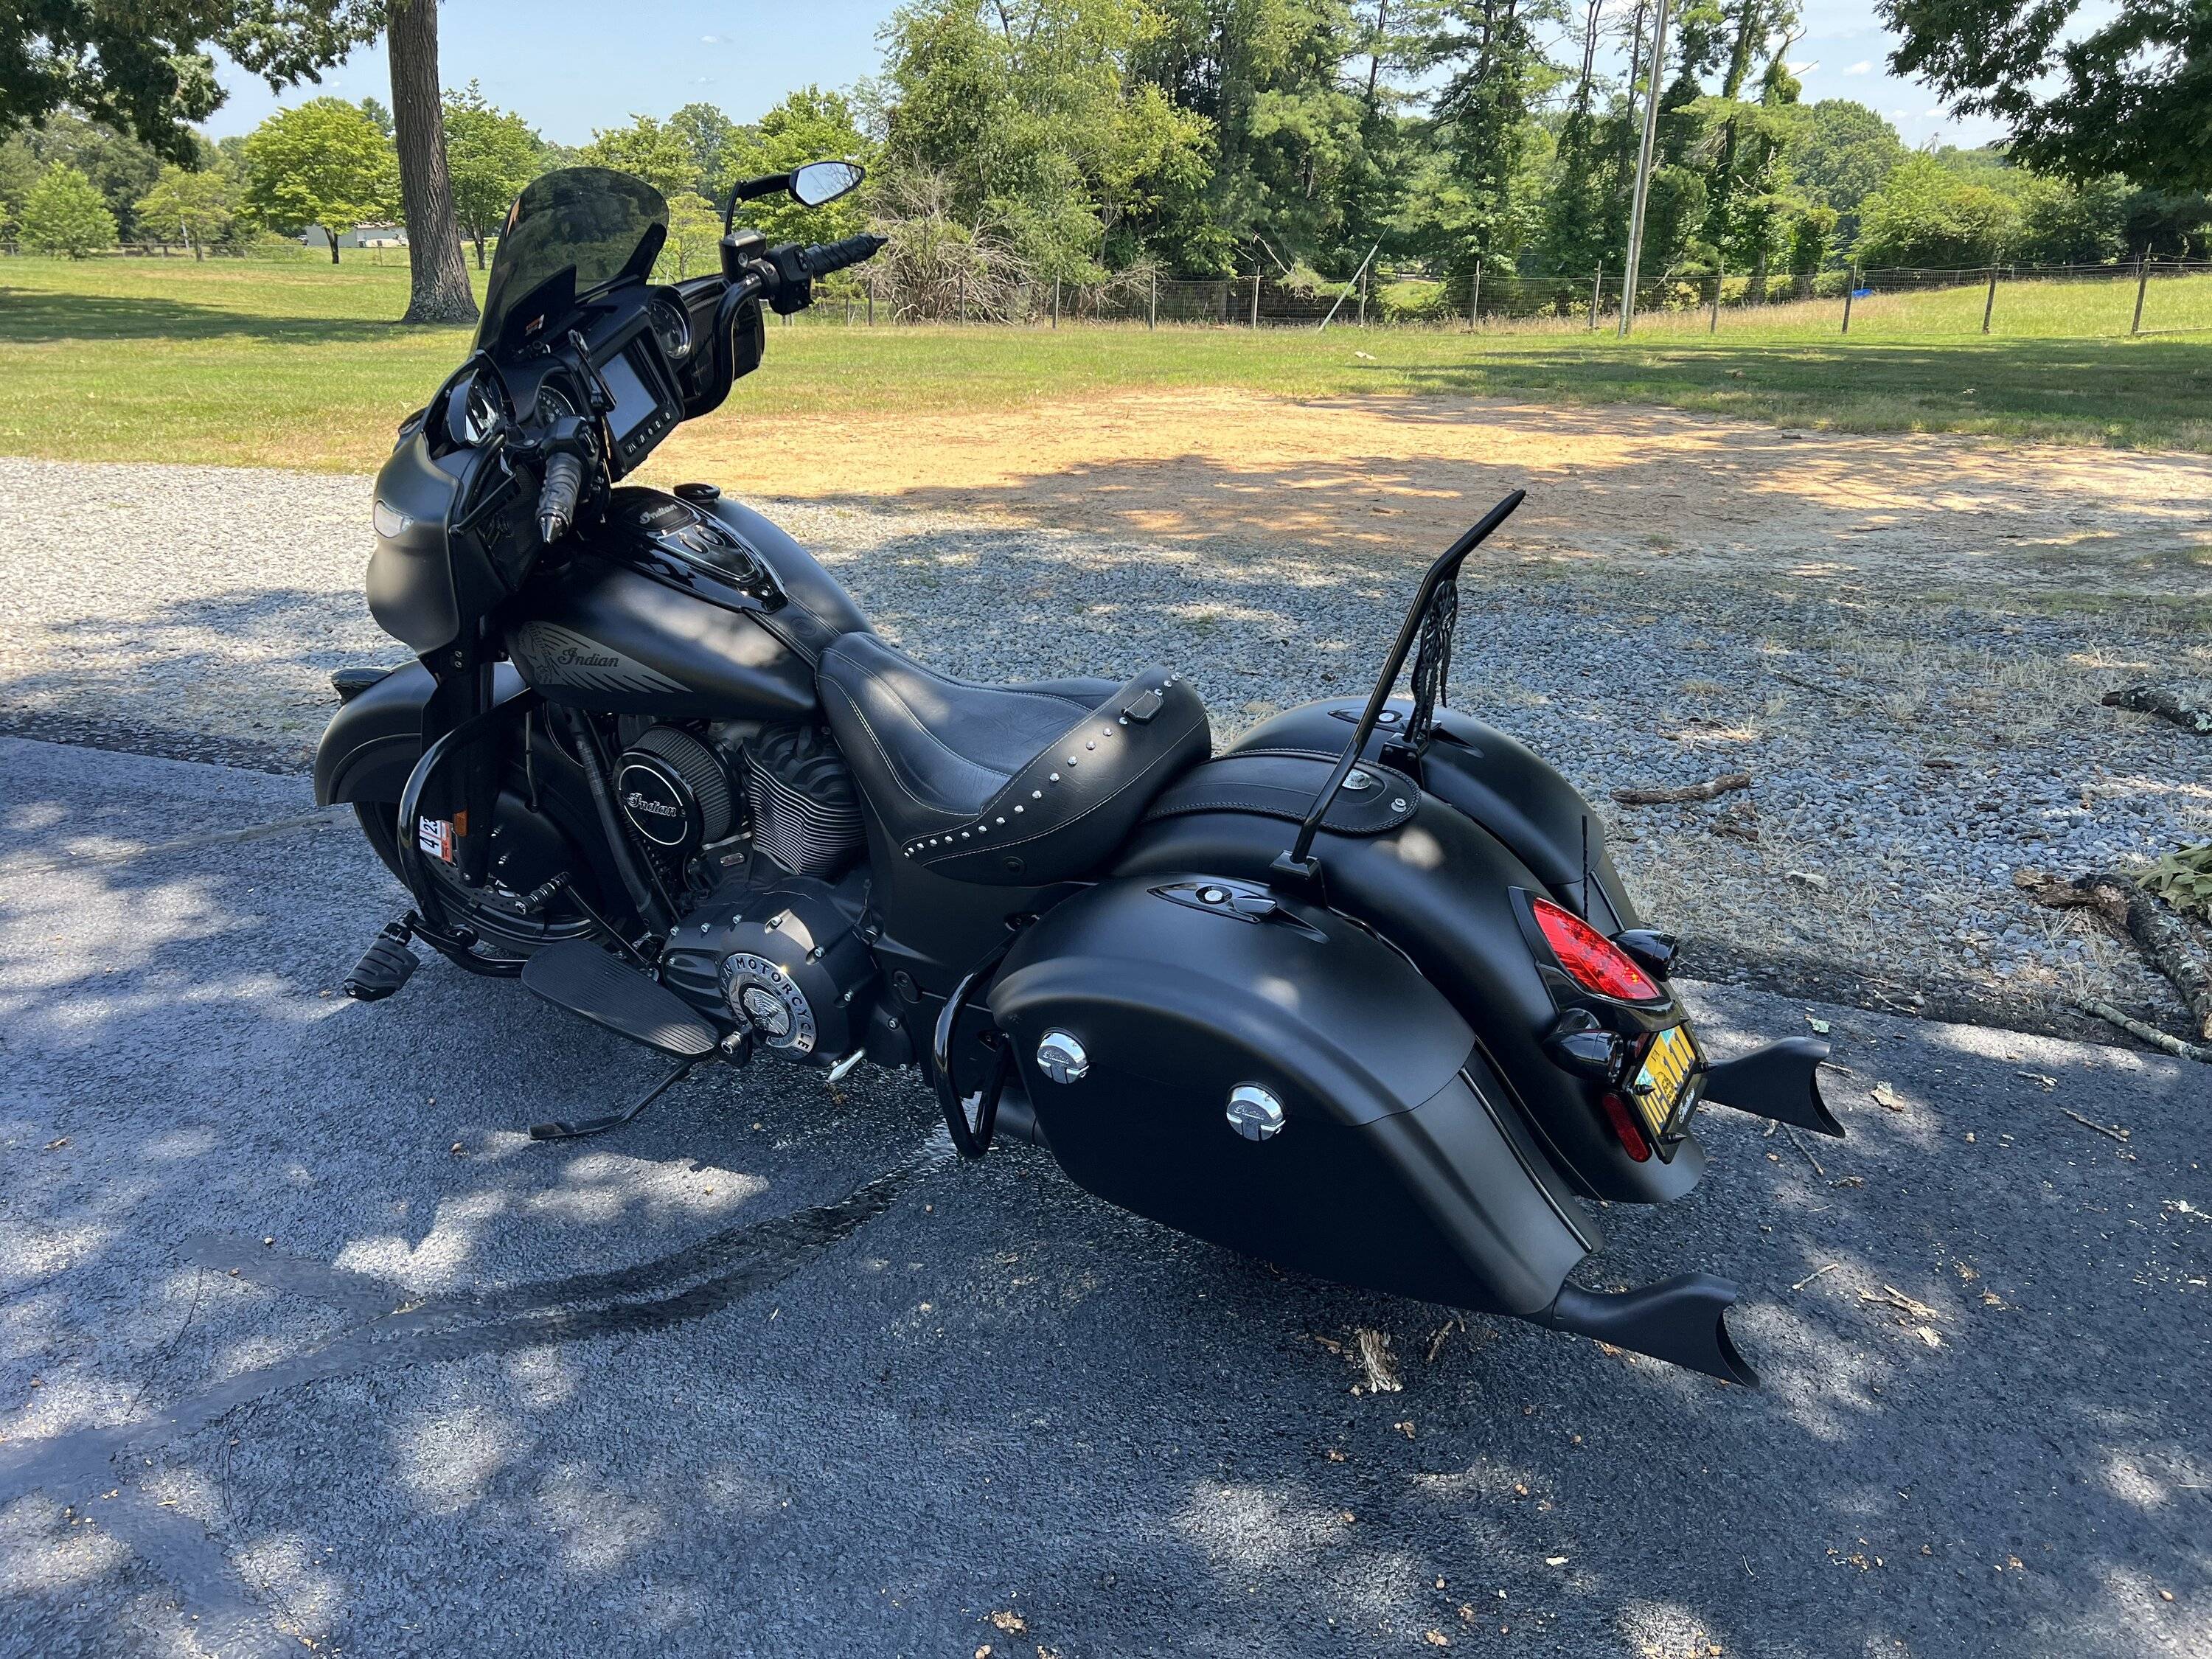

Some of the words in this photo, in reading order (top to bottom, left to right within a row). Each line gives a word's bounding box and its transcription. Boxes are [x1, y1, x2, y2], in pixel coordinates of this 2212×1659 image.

[639, 504, 678, 524] Indian
[557, 647, 619, 667] Indian
[626, 792, 677, 816] Indian
[420, 835, 439, 849] 4
[736, 957, 812, 1049] MOTORCYCLE
